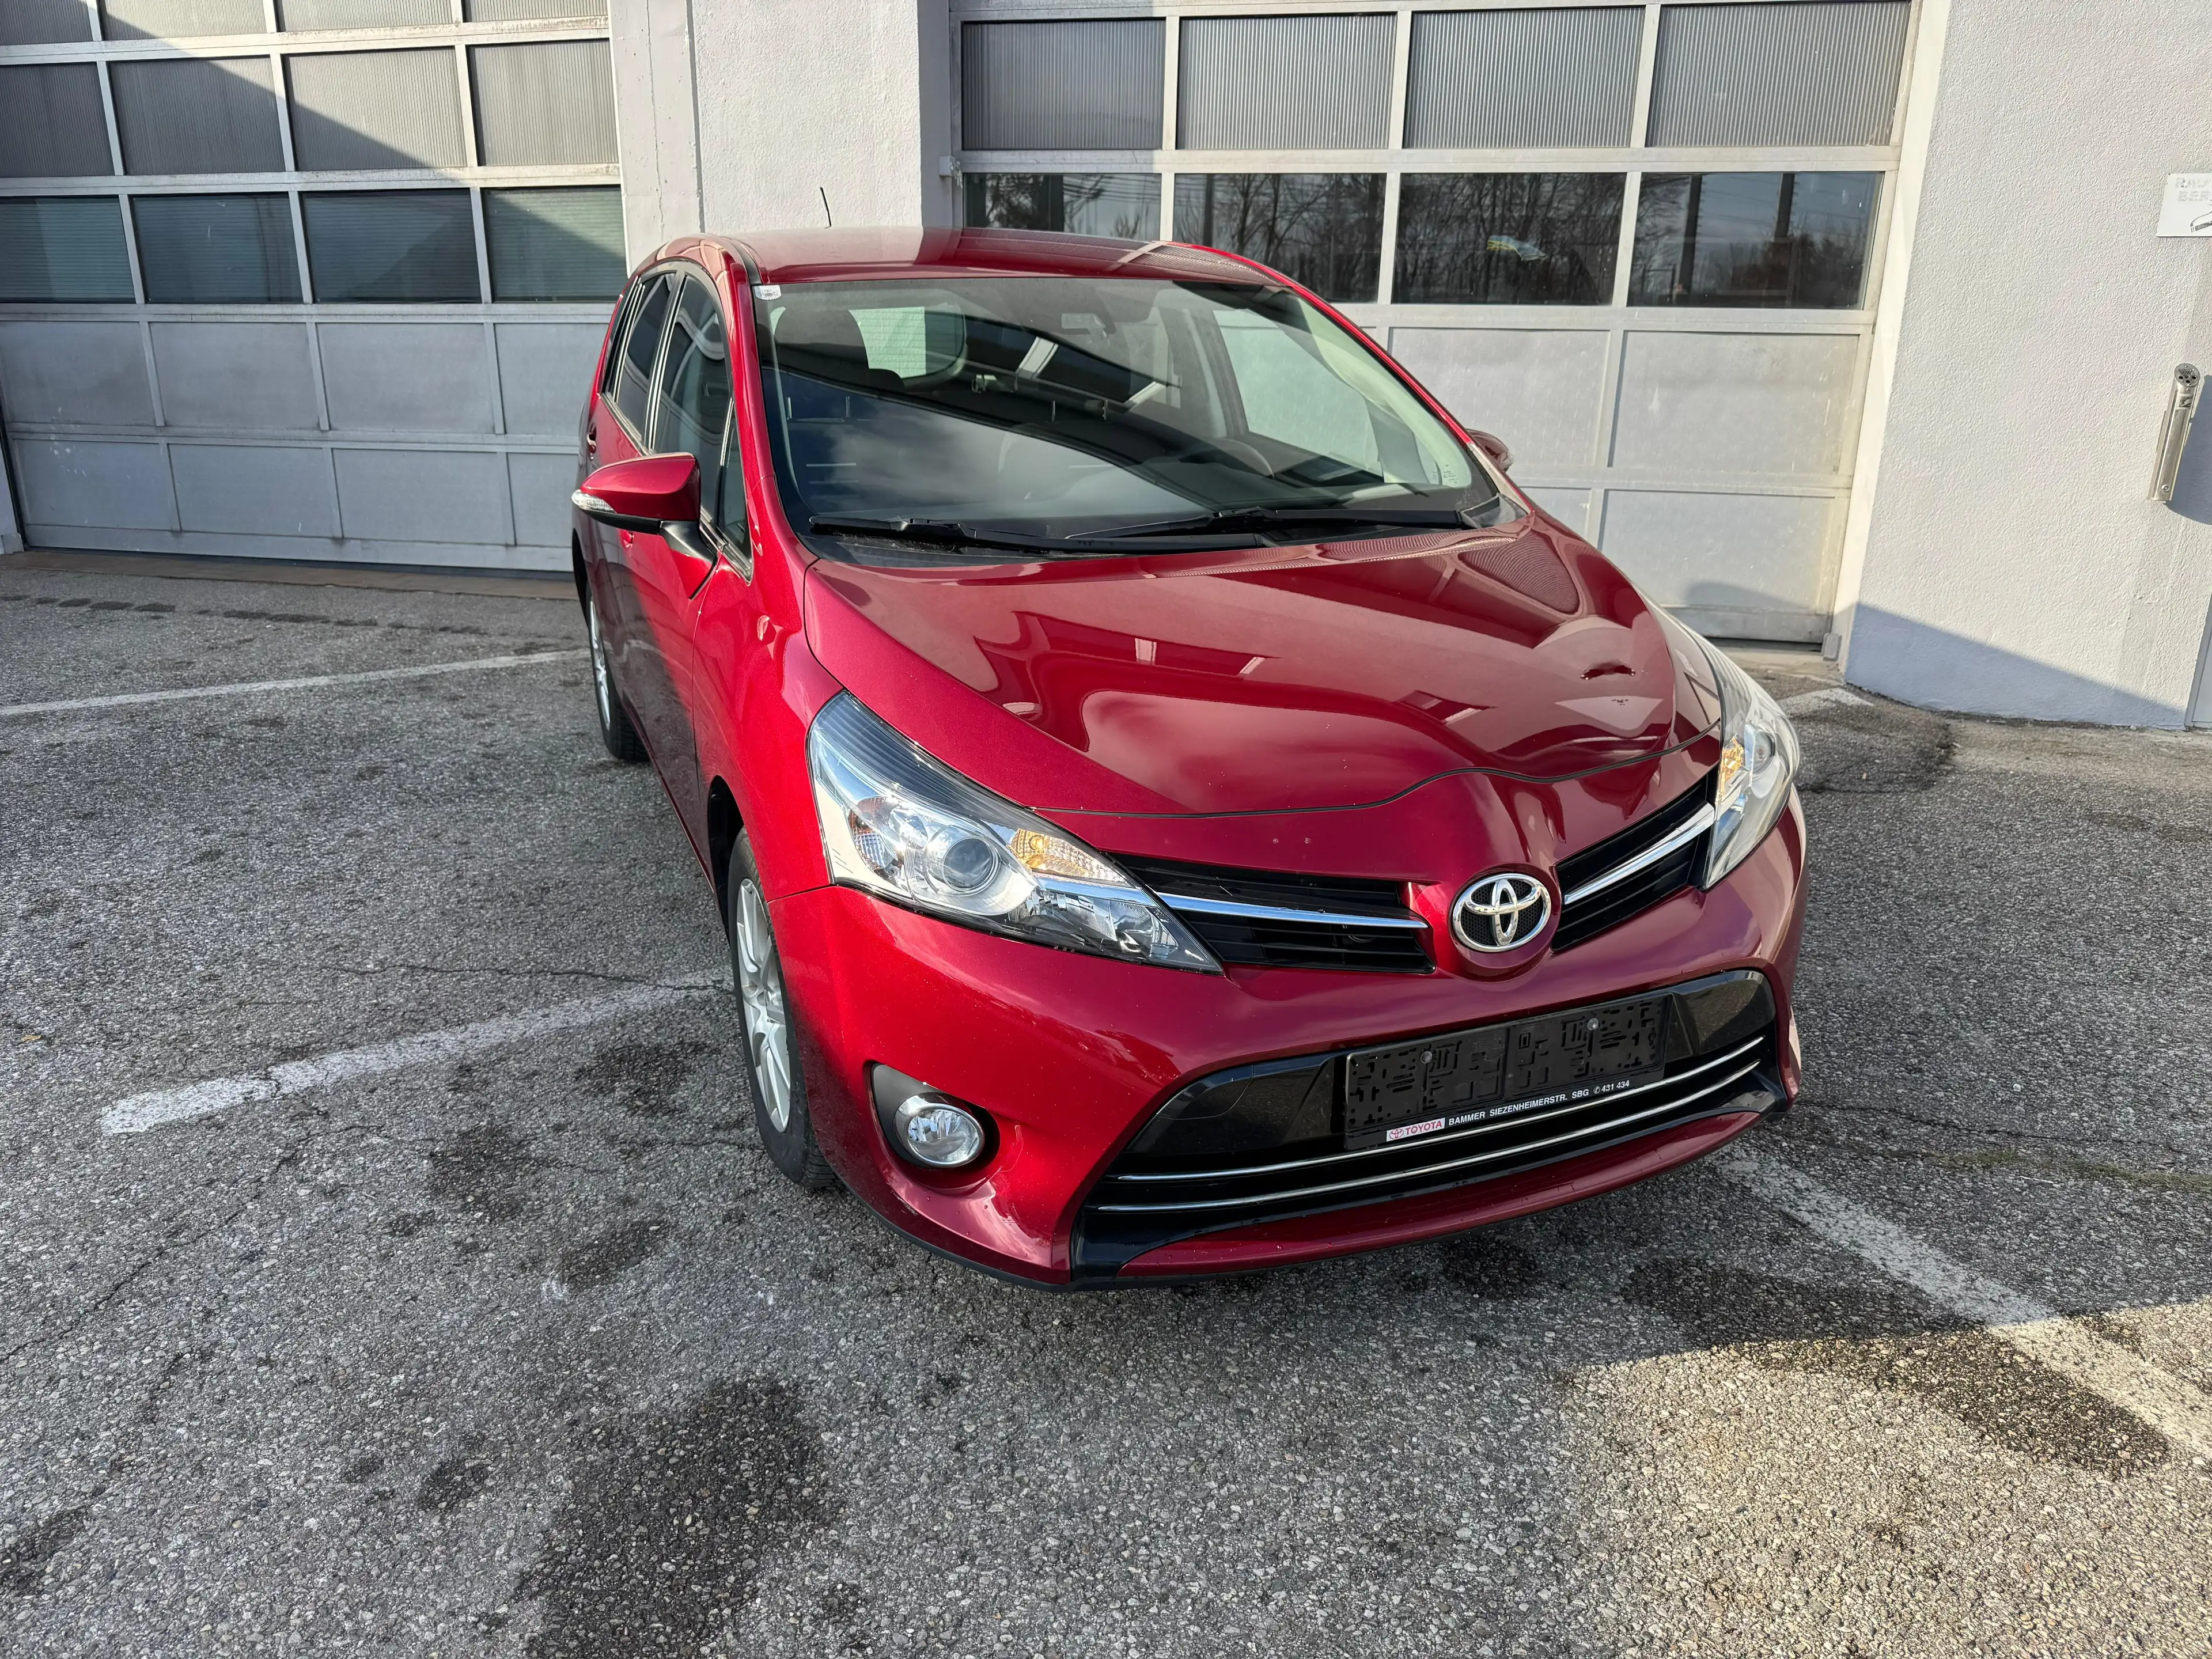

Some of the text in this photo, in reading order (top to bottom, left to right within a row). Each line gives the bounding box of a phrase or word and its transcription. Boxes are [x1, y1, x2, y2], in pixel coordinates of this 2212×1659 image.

[1405, 1080, 1630, 1135] TOYOTA BAMMER SIEZENHEIMERSTR. SBG 431 434
